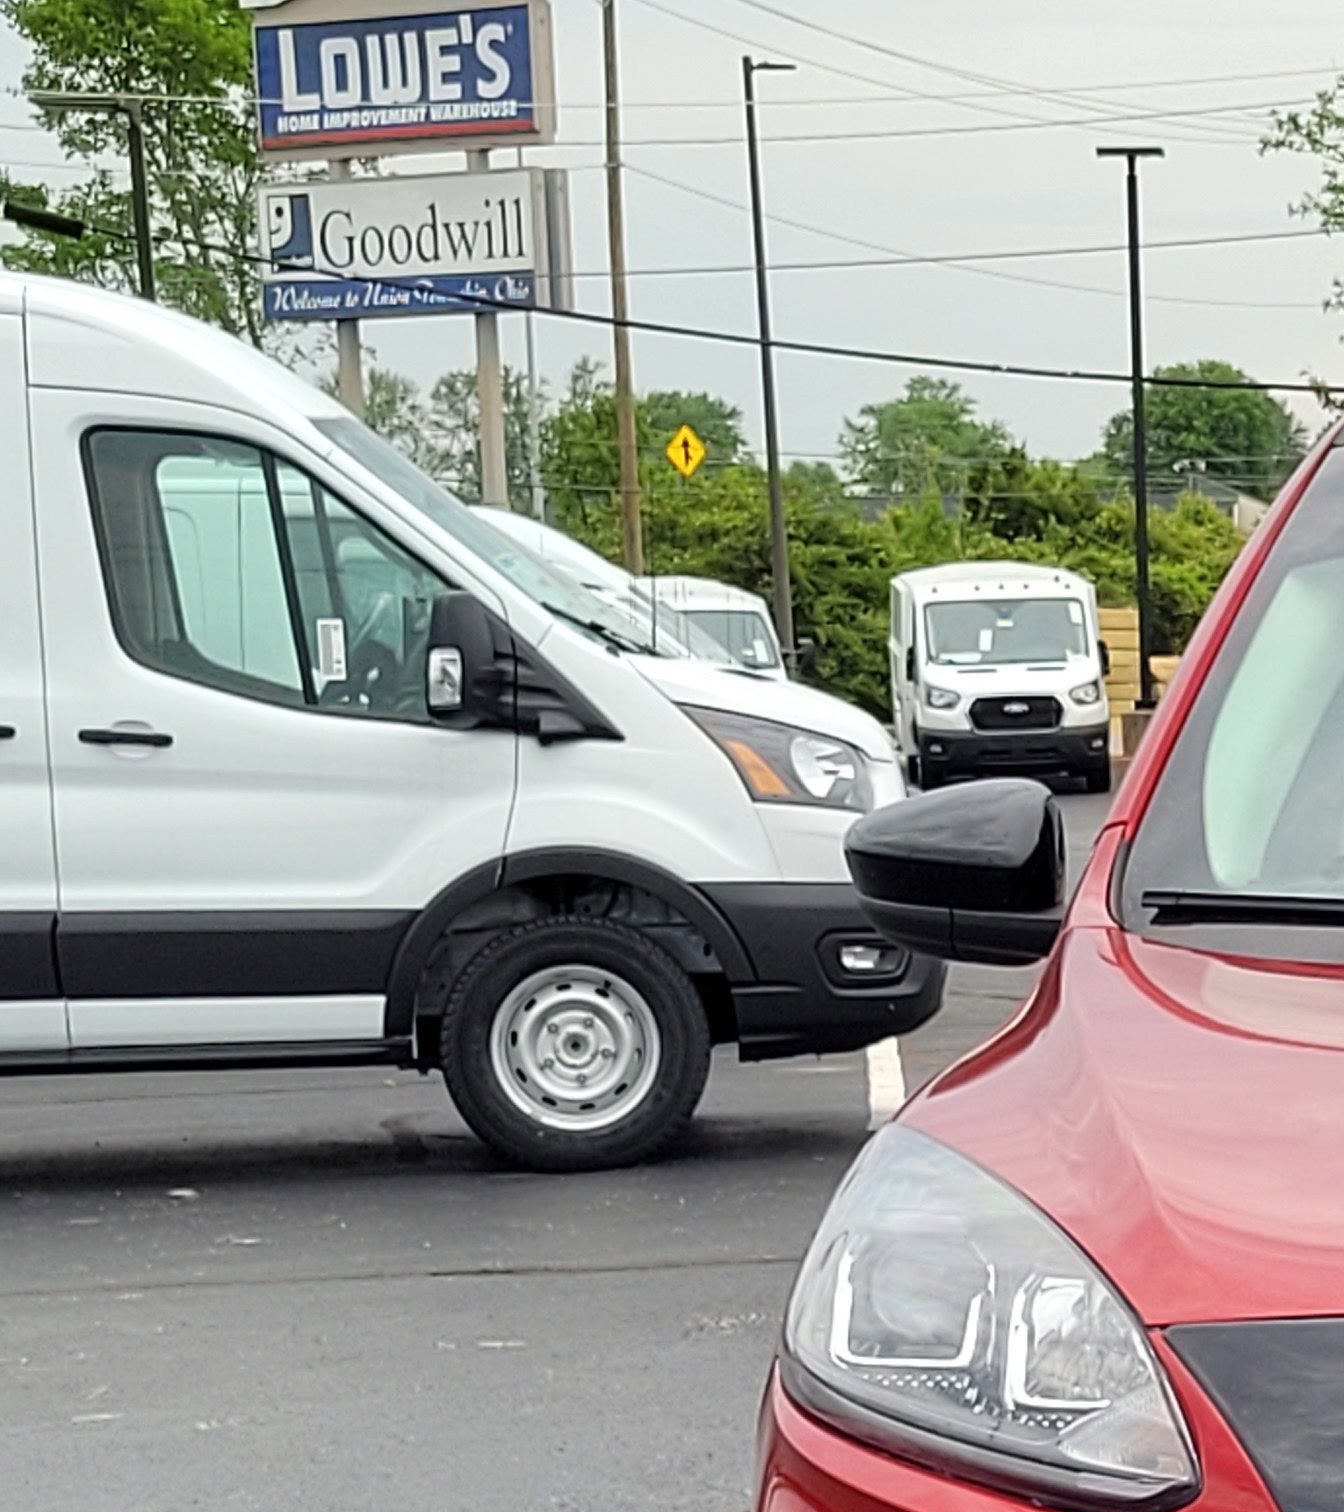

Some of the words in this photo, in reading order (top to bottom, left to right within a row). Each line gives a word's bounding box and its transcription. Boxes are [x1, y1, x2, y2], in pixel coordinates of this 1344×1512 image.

[277, 14, 513, 112] LOWE'S
[277, 115, 320, 133] HOME
[323, 105, 428, 129] IMPROVEMENT
[430, 99, 518, 122] WAREHOUSE
[319, 197, 527, 269] Goodwill
[272, 286, 341, 312] Welcome
[345, 289, 360, 309] to
[362, 281, 410, 308] Union
[494, 274, 530, 301] Ohio
